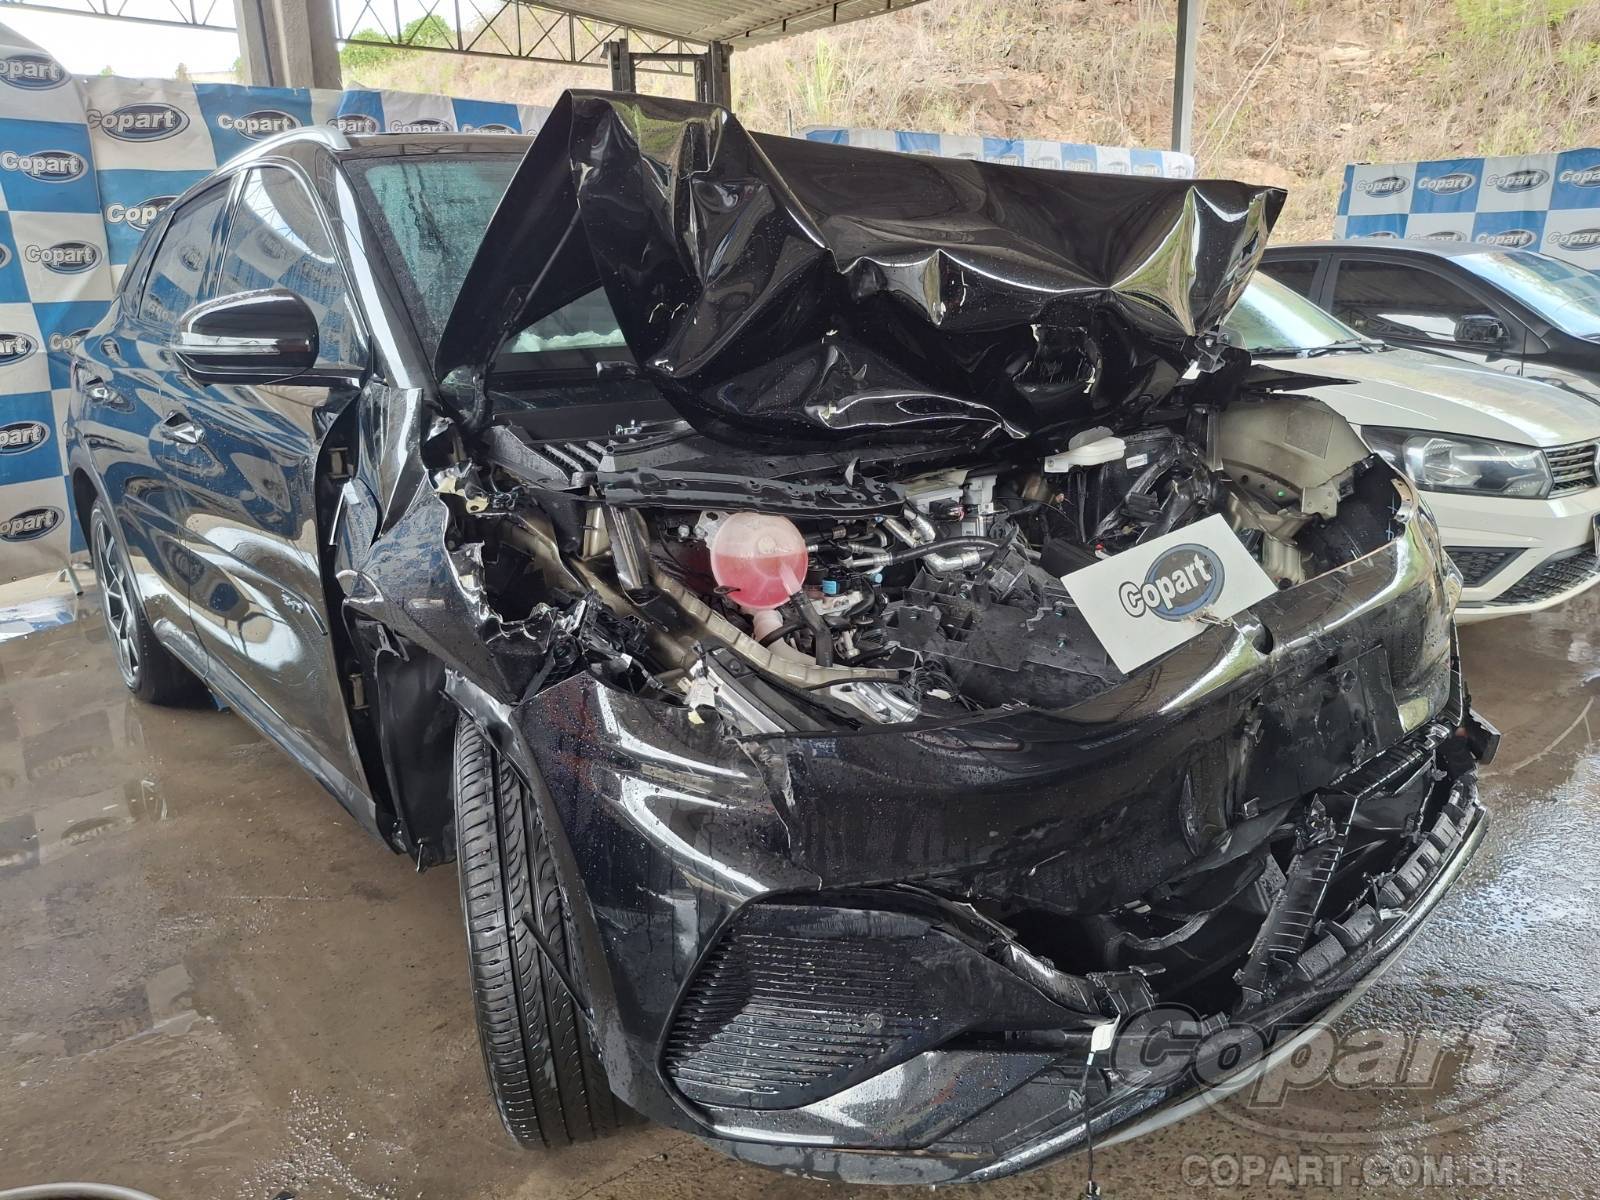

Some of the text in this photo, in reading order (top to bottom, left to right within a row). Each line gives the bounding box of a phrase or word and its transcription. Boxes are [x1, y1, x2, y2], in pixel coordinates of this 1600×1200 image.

[86, 108, 176, 132] Copart
[217, 113, 292, 135] Copart
[1, 151, 80, 175] Copart
[1355, 178, 1402, 194] Copart
[1418, 176, 1470, 192] Copart
[1485, 173, 1541, 188] Copart
[106, 203, 165, 225] Cop
[25, 245, 94, 267] Copart
[1119, 553, 1213, 618] Copart
